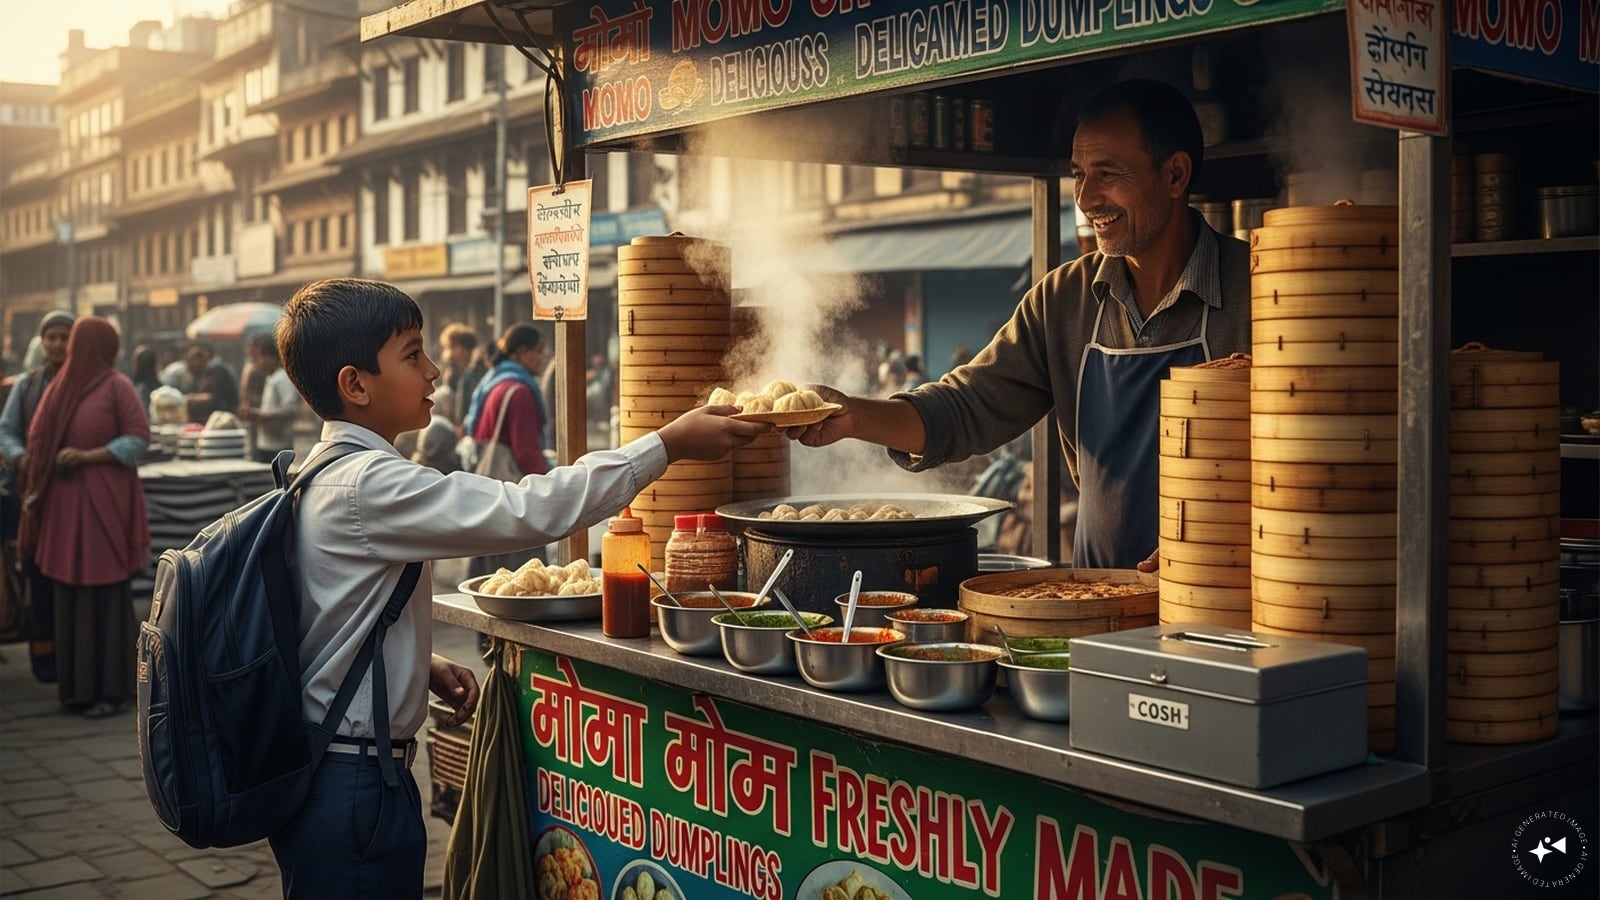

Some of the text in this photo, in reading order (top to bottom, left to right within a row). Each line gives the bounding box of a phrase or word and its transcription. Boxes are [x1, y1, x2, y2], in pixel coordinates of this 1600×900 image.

[582, 75, 652, 132] MOMO
[710, 32, 829, 106] DELICIOUSS
[855, 0, 1009, 80] DELICAMED
[1138, 701, 1181, 724] COSH
[531, 655, 648, 788] मोमा
[664, 693, 797, 837] मोम
[810, 749, 1015, 898] FRESHLY
[537, 766, 782, 900] DELICIOUED DUMPLINGS
